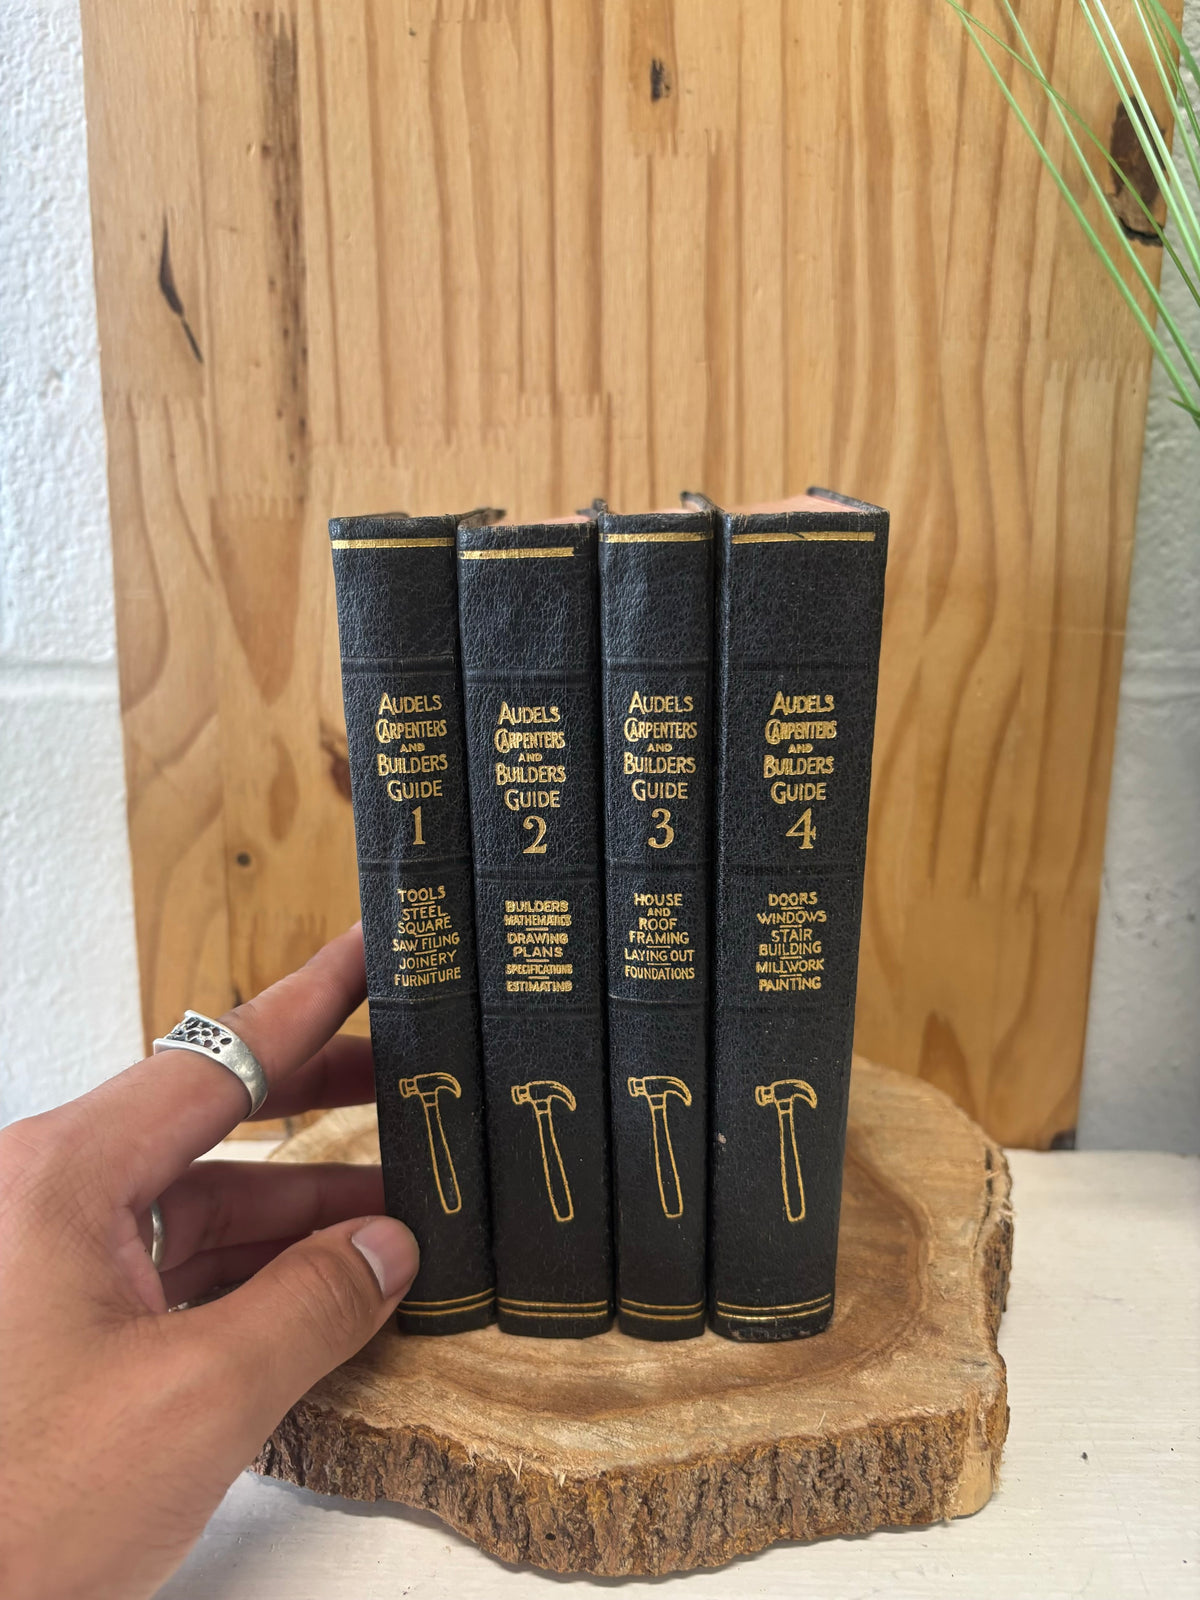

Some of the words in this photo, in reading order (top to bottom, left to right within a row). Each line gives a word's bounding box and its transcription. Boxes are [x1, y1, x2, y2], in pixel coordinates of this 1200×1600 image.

[378, 692, 442, 715] AUDELS
[628, 691, 694, 714] AUDELS
[770, 691, 835, 715] AUDELS
[497, 701, 560, 725] AUDELS
[375, 718, 447, 743] CARPENTERS
[623, 717, 697, 742] CARPENTERS
[765, 719, 837, 745] CARPENTERS
[400, 743, 425, 752] AND
[494, 728, 566, 753] CARPENTERS
[647, 743, 672, 752] AND
[788, 744, 813, 753] AND
[376, 753, 448, 776] BUILDERS
[518, 753, 543, 762] AND
[623, 752, 696, 774] BUILDERS
[763, 755, 835, 778] BUILDERS
[495, 762, 566, 785] BUILDERS
[387, 780, 443, 801] GUIDE
[631, 779, 688, 801] GUIDE
[770, 782, 827, 804] GUIDE
[504, 789, 560, 811] GUIDE
[411, 806, 426, 845] 1
[522, 815, 547, 853] 2
[647, 808, 675, 848] 3
[785, 807, 817, 849] 4
[397, 885, 446, 902] TOOLS
[633, 892, 683, 906] HOUSE
[768, 891, 818, 906] DOORS
[402, 905, 448, 921] STEEL
[504, 900, 569, 913] BUILDERS
[647, 907, 671, 917] AND
[397, 916, 452, 935] SQUARE
[503, 914, 572, 927] MATHEMATICS
[638, 916, 678, 931] ROOF
[756, 910, 827, 925] WINDOWS
[392, 939, 418, 952] SAW
[421, 932, 460, 950] FILING
[507, 932, 569, 945] DRAWING
[628, 930, 690, 945] FRAMING
[770, 928, 813, 943] STAIR
[512, 946, 563, 958] PLANS
[624, 947, 668, 962] LAYING
[670, 949, 695, 962] OUT
[759, 941, 822, 956] BUILDING
[399, 949, 457, 970] JOINERY
[755, 958, 825, 974] MILLWORK
[394, 966, 461, 987] FURNITURE
[505, 963, 573, 975] SPECIFICATIONS
[624, 964, 695, 980] FOUNDATIONS
[506, 980, 573, 992] ESTIMATING
[758, 975, 822, 992] PAINTING
